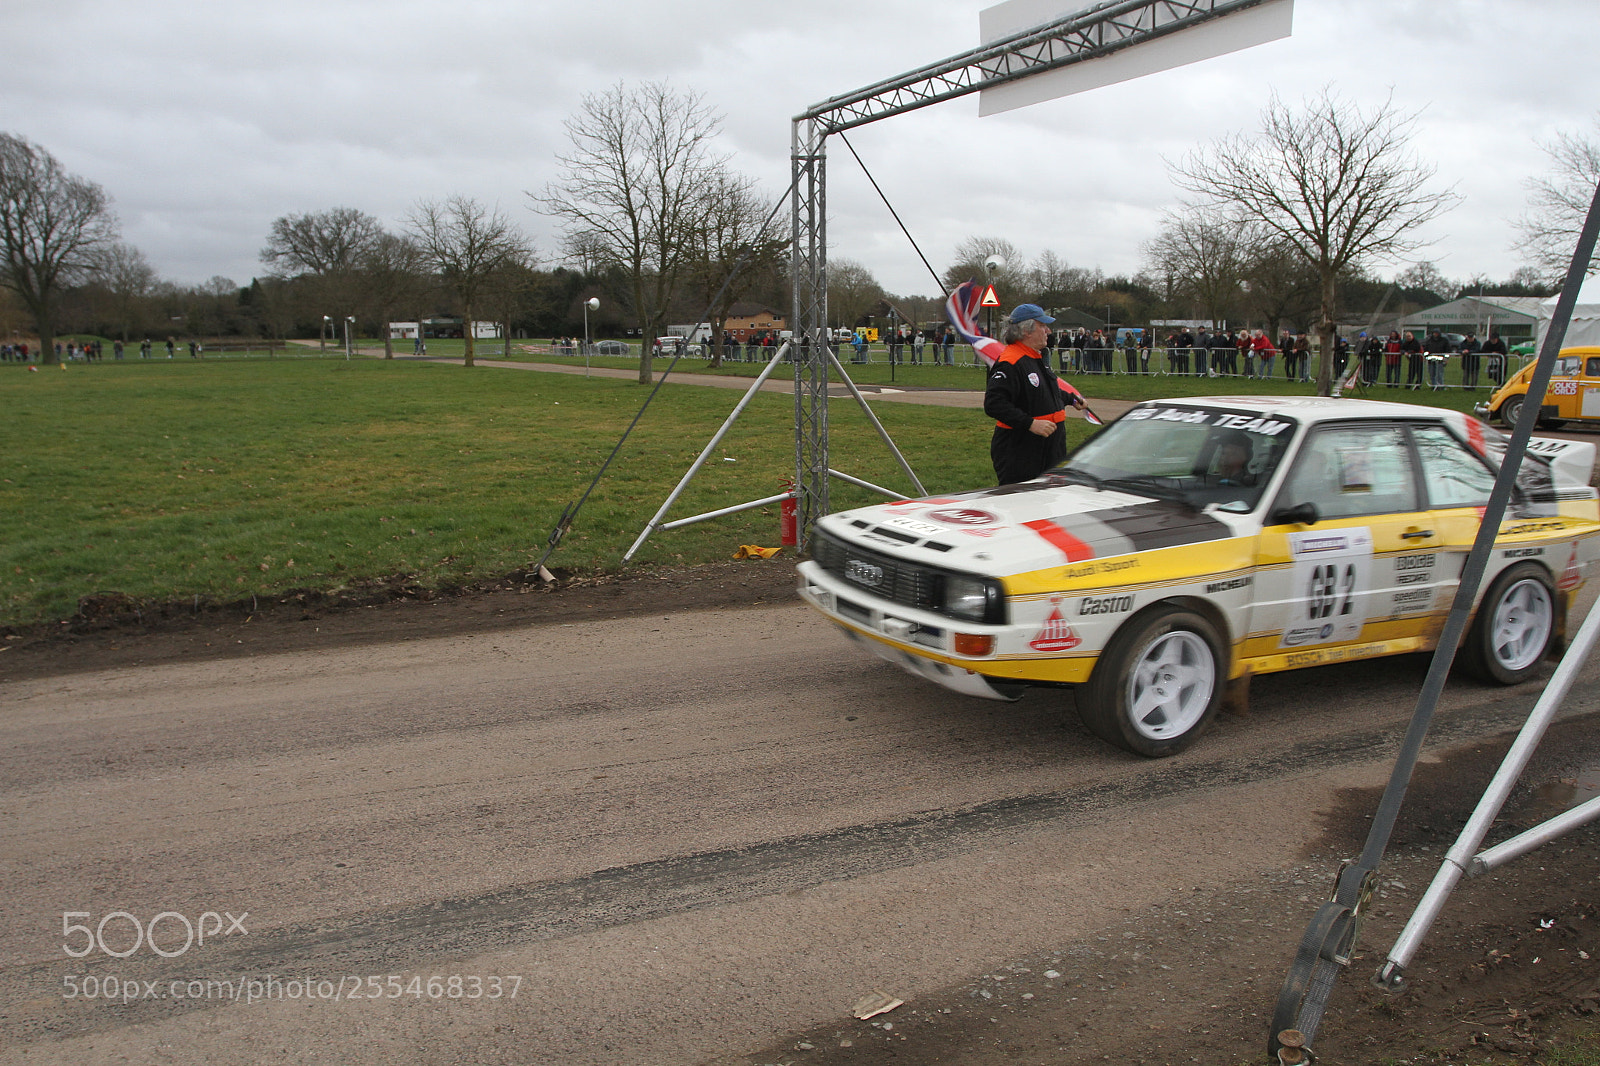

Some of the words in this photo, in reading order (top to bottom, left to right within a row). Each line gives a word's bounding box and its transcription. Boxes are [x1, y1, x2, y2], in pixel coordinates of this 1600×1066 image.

[1211, 413, 1291, 436] TEAM
[1503, 547, 1545, 558] MICHELIN
[1098, 559, 1140, 574] Sport
[1204, 576, 1254, 594] MICHELIN
[1078, 594, 1136, 616] Castrol
[1043, 619, 1071, 640] HB
